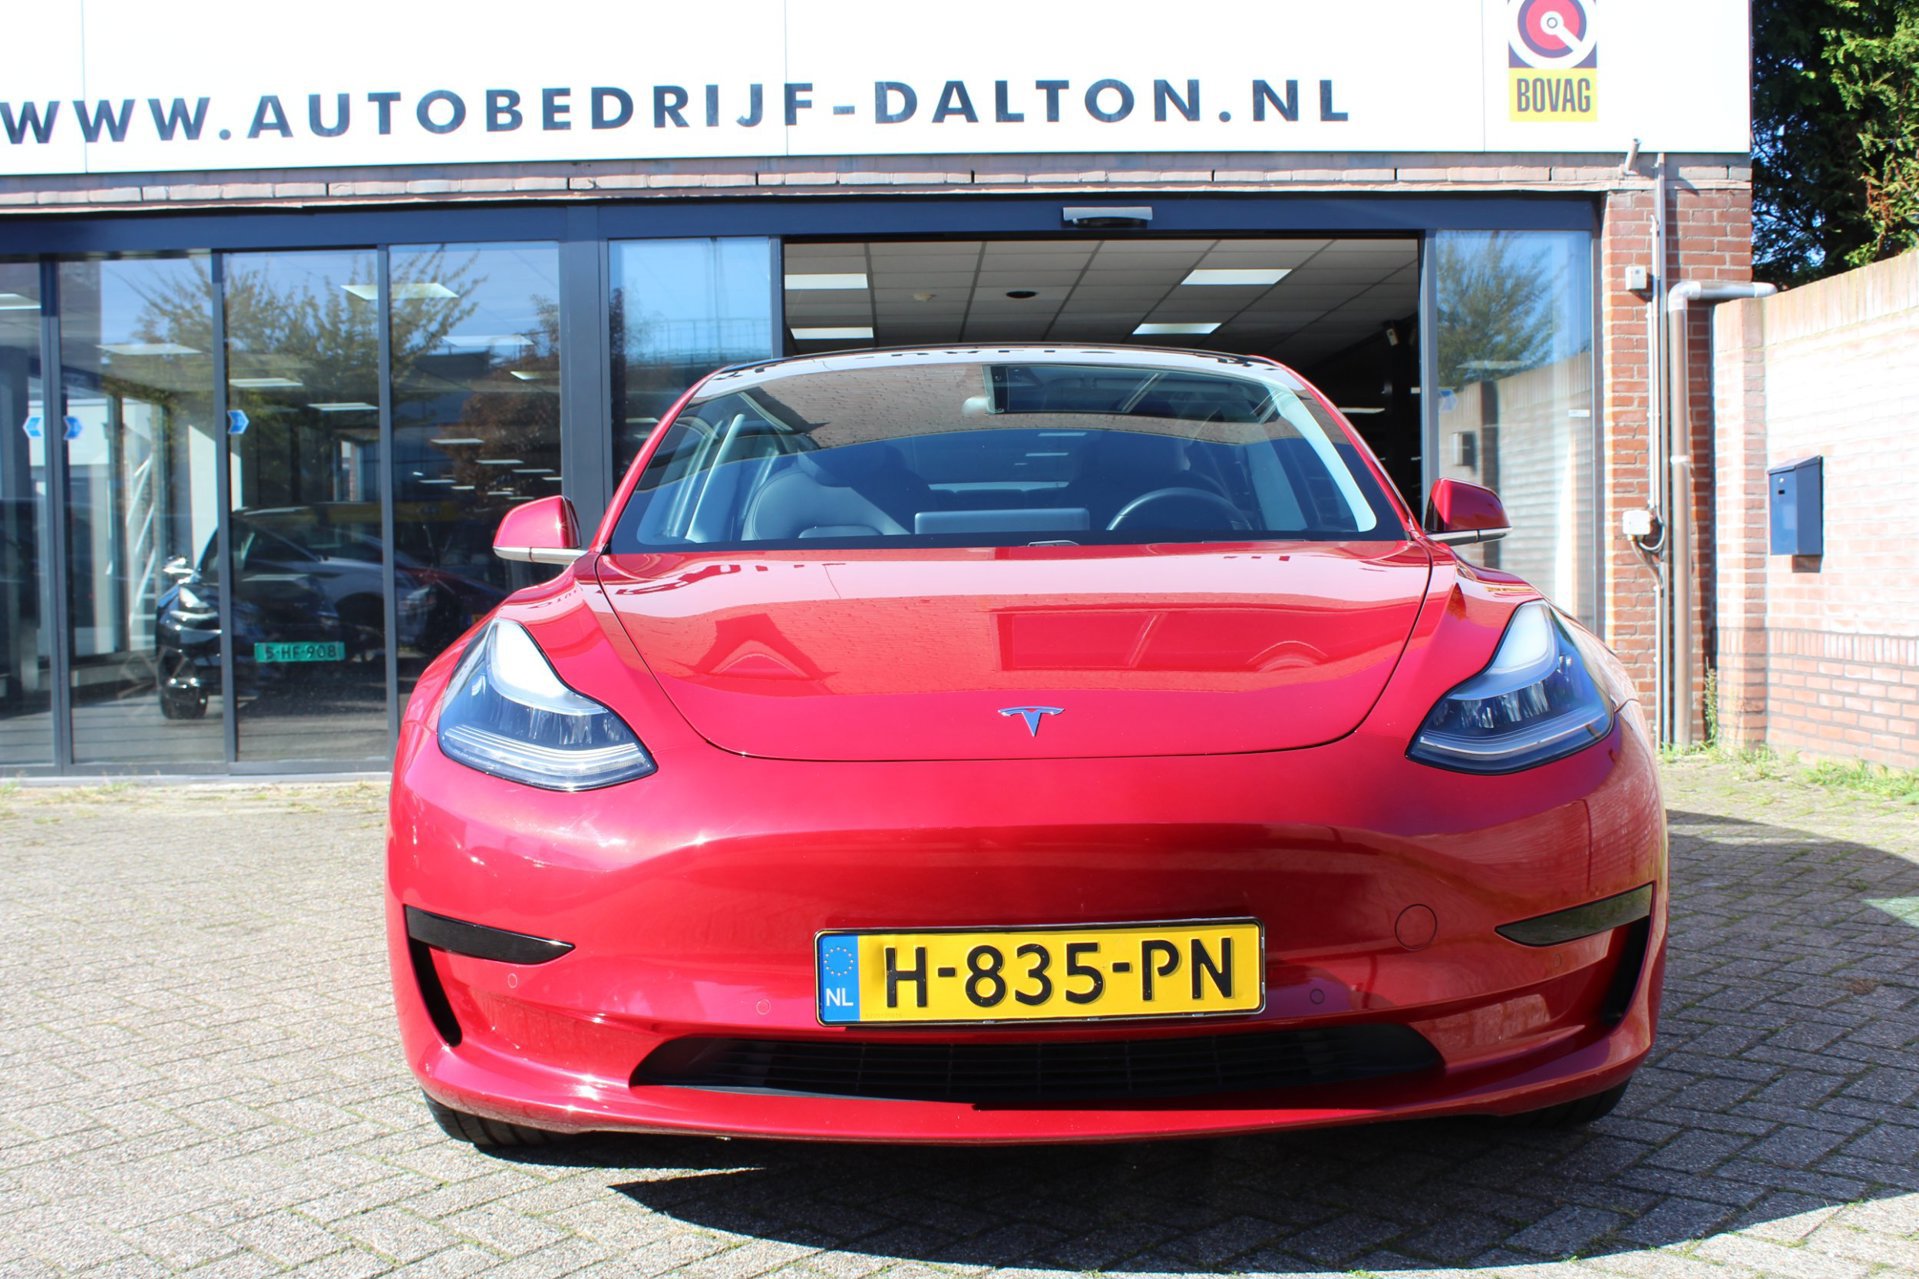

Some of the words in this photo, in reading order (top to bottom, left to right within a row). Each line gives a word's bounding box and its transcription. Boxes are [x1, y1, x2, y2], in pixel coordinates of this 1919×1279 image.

[0, 79, 1348, 145] WWW.AUTOBEDRIJF-DALTON.NL
[1516, 77, 1591, 112] BOVAG
[825, 987, 854, 1007] NL
[885, 937, 1232, 1008] H-835-PN
